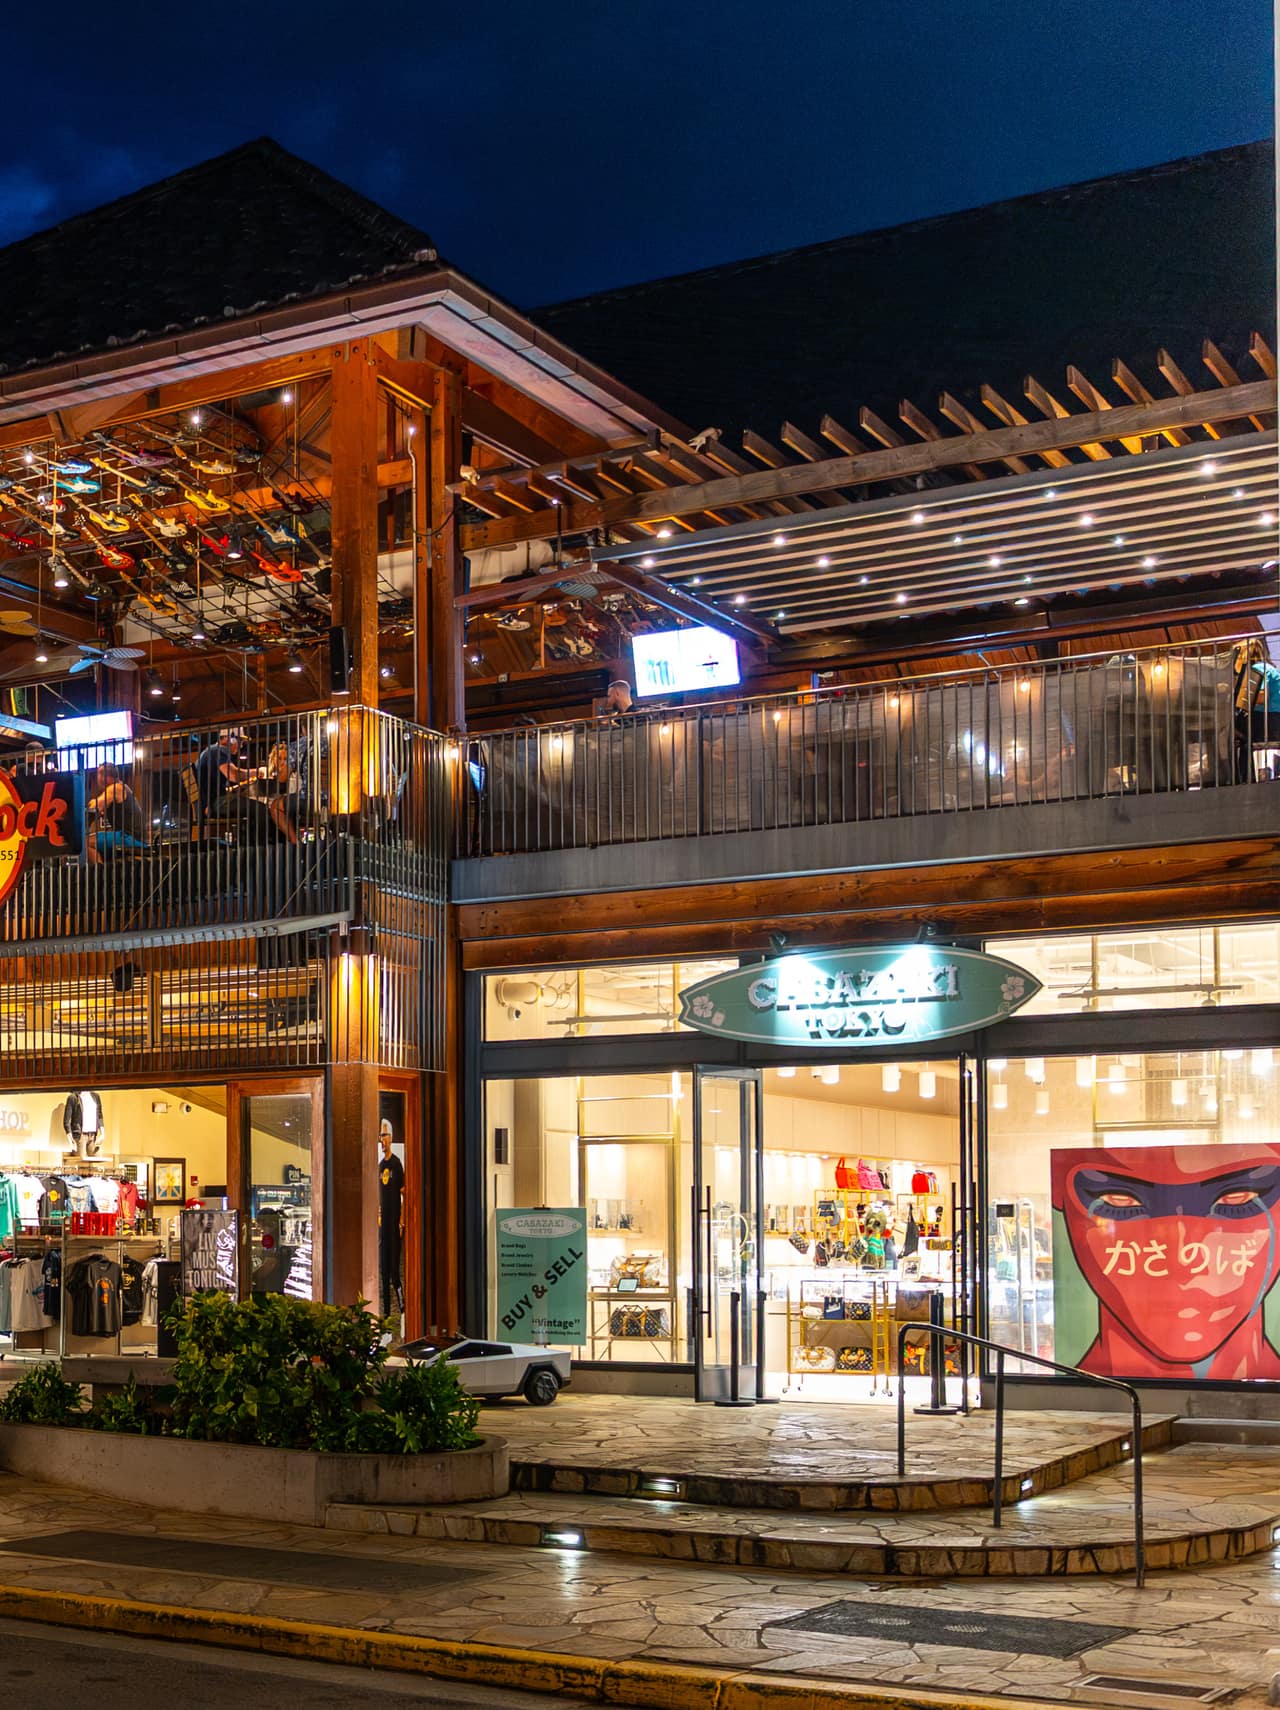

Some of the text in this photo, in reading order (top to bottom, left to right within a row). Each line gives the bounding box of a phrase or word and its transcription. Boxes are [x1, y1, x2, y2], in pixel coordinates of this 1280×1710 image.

[198, 1232, 218, 1250] LIV
[192, 1251, 217, 1269] MUS
[186, 1270, 226, 1288] TONIG
[501, 1247, 584, 1331] BUY & SELL
